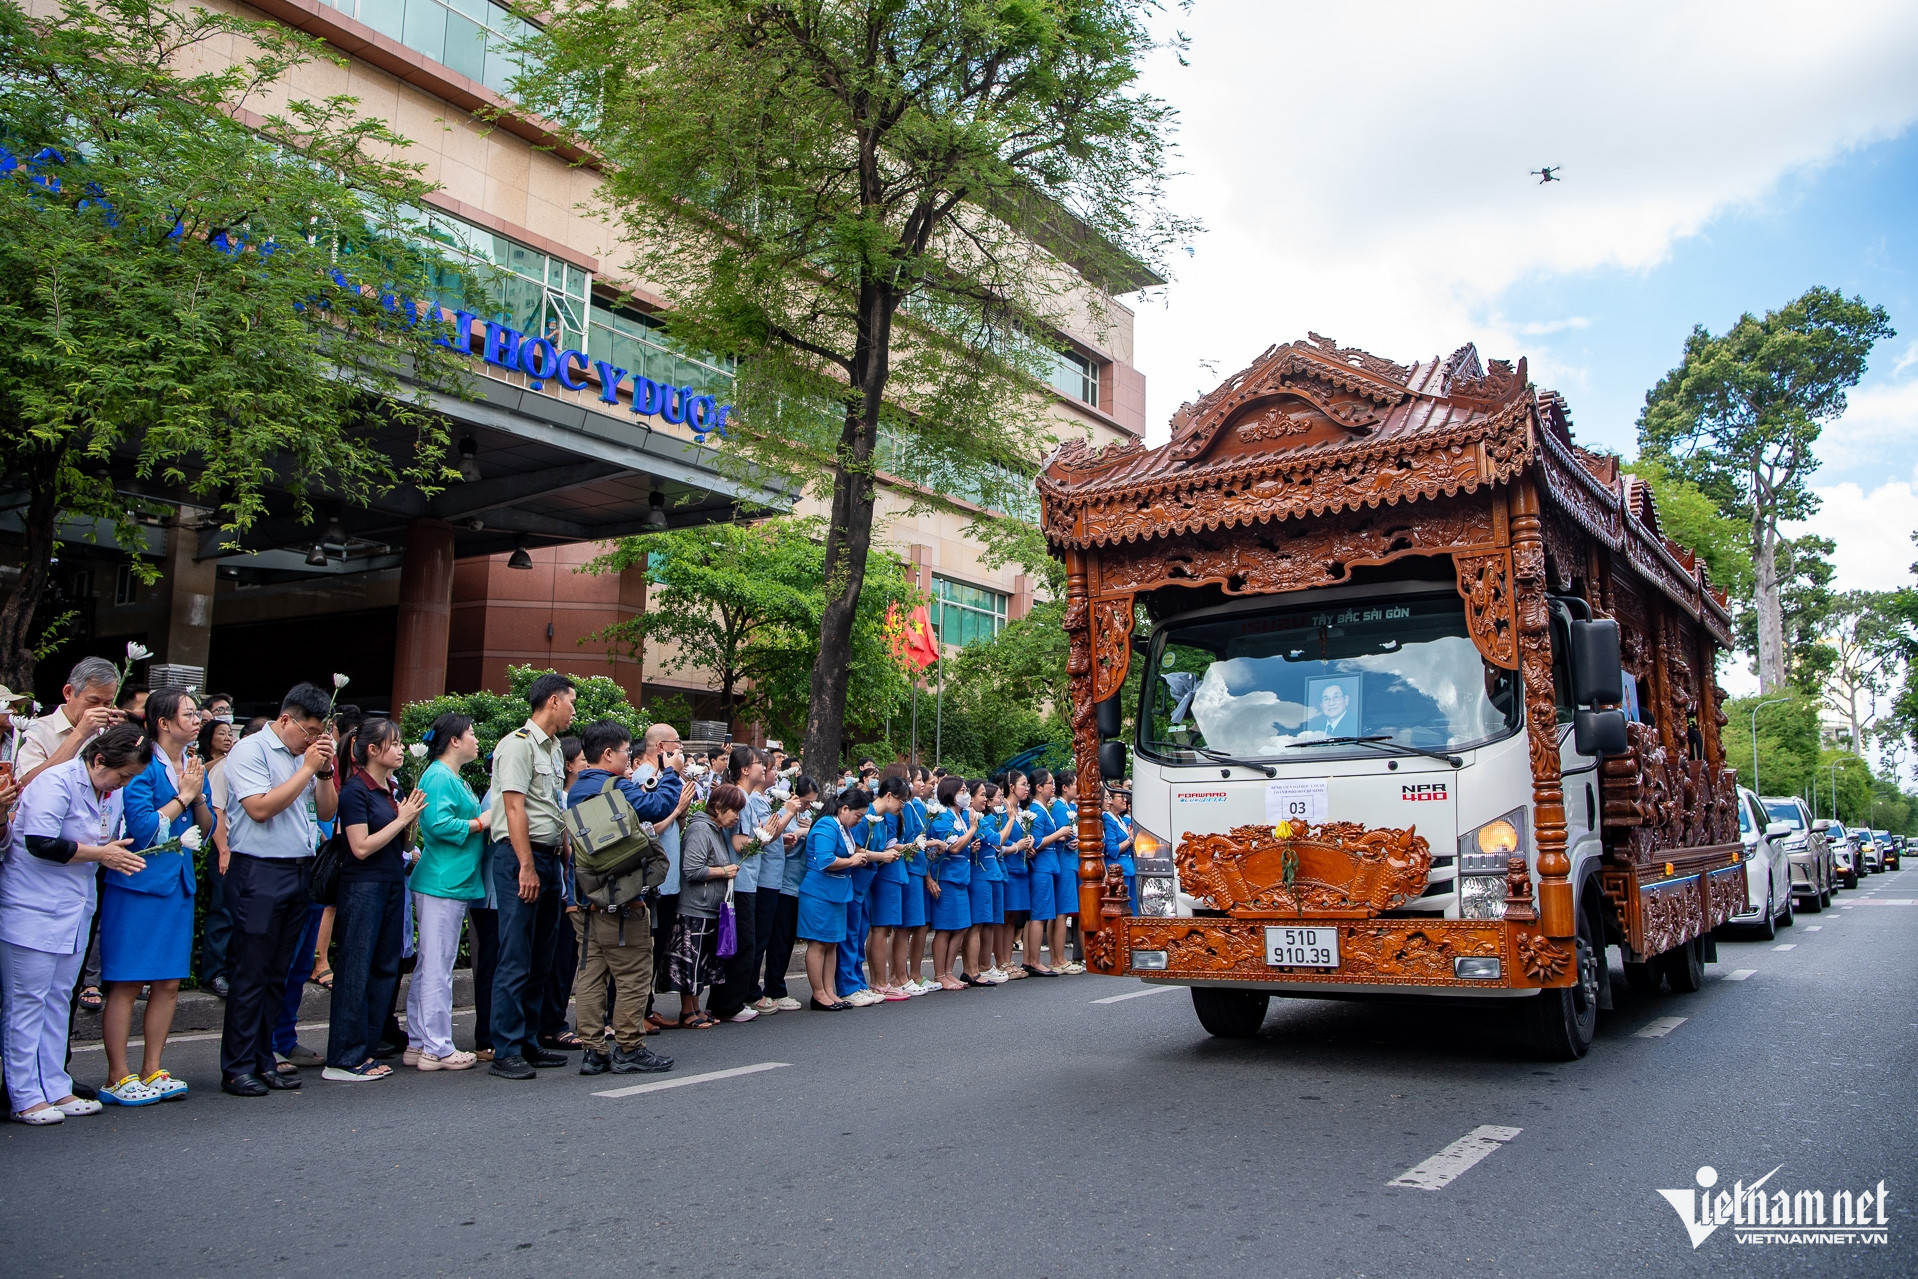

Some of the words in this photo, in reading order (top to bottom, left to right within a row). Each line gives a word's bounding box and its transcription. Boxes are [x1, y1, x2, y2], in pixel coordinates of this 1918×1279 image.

[482, 319, 589, 391] HỌC
[594, 360, 628, 405] Y
[1312, 612, 1334, 626] TÂY
[1337, 608, 1360, 624] BẮC
[1362, 608, 1382, 621] SÀI
[1385, 605, 1410, 619] GÒN
[1402, 783, 1447, 793] NPR
[1402, 791, 1448, 801] 400
[1289, 801, 1306, 814] 03
[1285, 930, 1316, 946] 51D
[1274, 947, 1331, 963] 910.39
